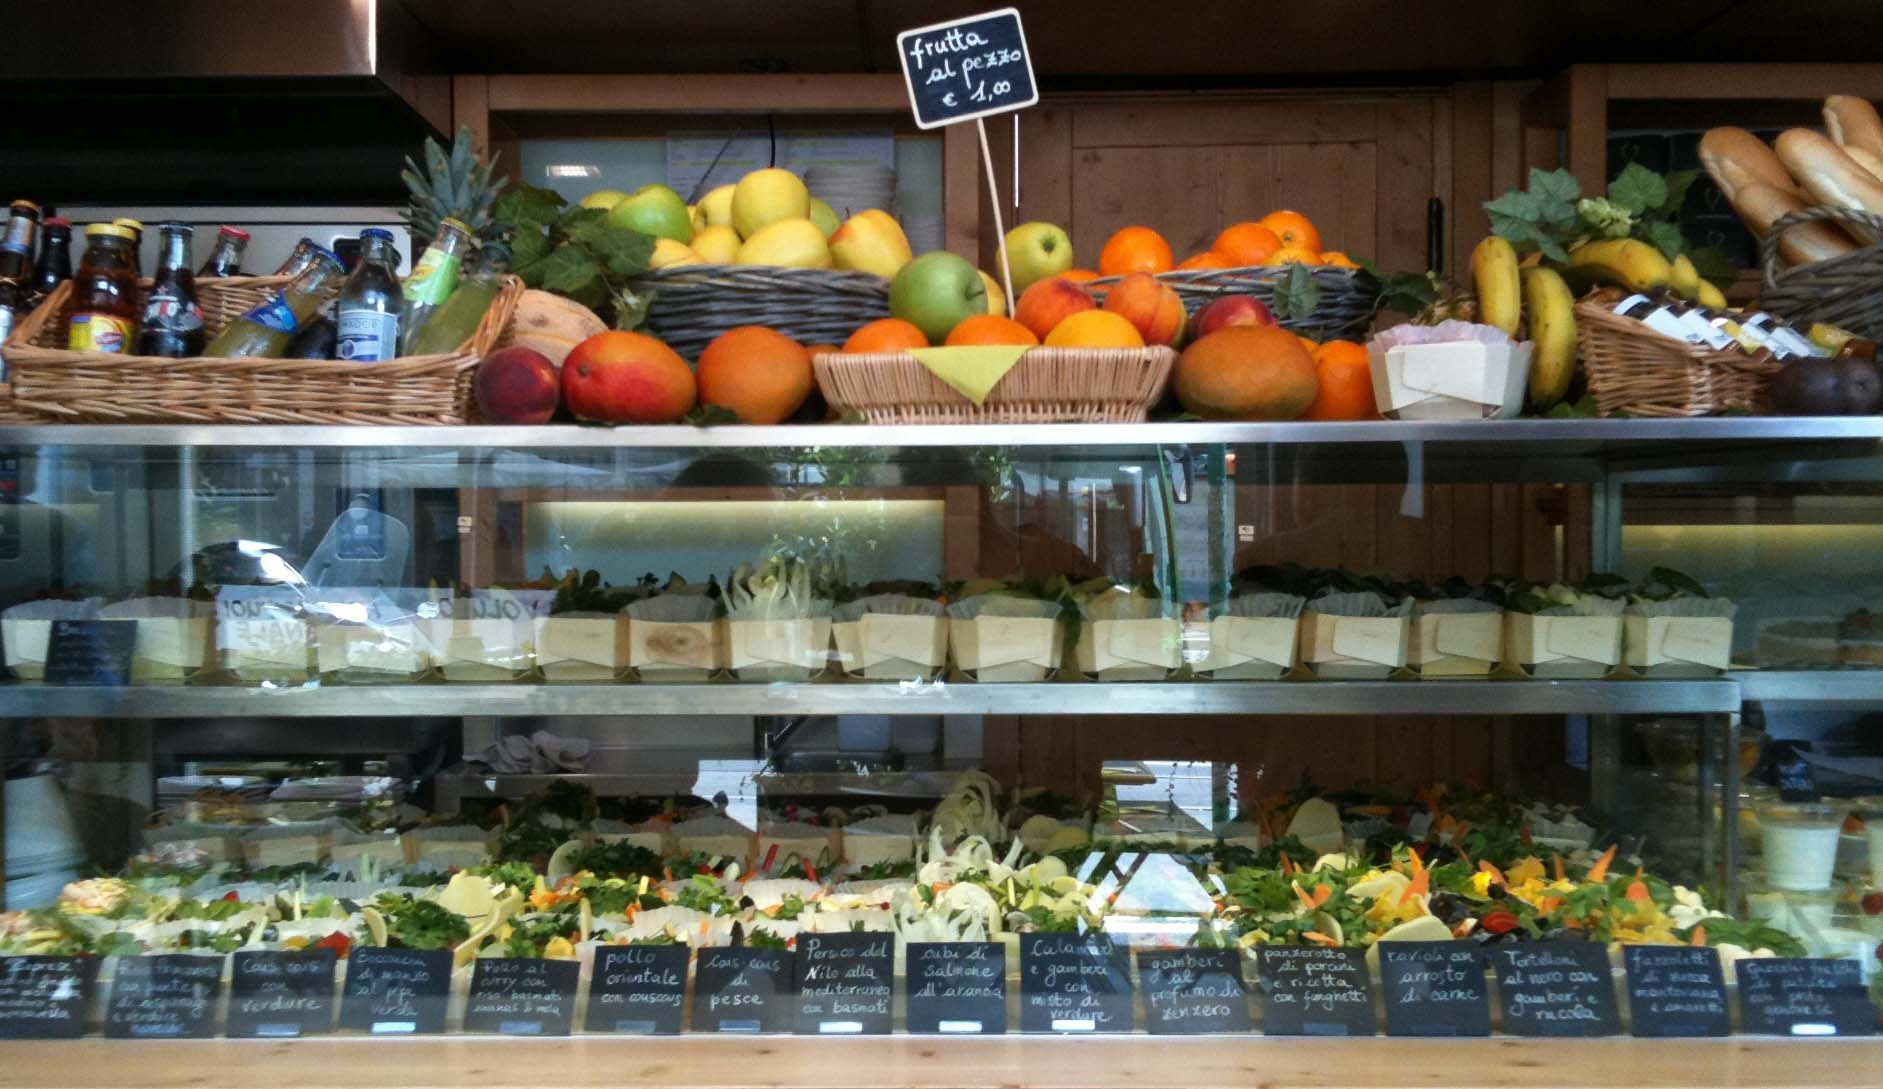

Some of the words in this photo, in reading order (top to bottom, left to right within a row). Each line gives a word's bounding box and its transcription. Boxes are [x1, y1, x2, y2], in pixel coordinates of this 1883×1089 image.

[910, 28, 989, 70] frutta
[926, 58, 956, 85] al
[961, 48, 1021, 90] pezzo
[942, 92, 958, 107] €
[970, 79, 1011, 102] 1,00
[859, 940, 888, 957] del
[965, 945, 990, 960] di
[604, 948, 656, 972] pollo
[1150, 951, 1225, 984] gamberi
[1277, 960, 1298, 972] di
[606, 967, 680, 985] orientale
[729, 972, 751, 986] di
[804, 963, 840, 981] Nilo
[844, 963, 878, 980] alla
[1398, 964, 1467, 984] arrosto
[1504, 970, 1524, 985] al
[1064, 981, 1089, 992] con
[241, 995, 322, 1012] verdure
[710, 993, 765, 1011] pesce
[833, 999, 888, 1014] basmati
[1031, 992, 1072, 1007] misto
[1080, 993, 1101, 1007] di
